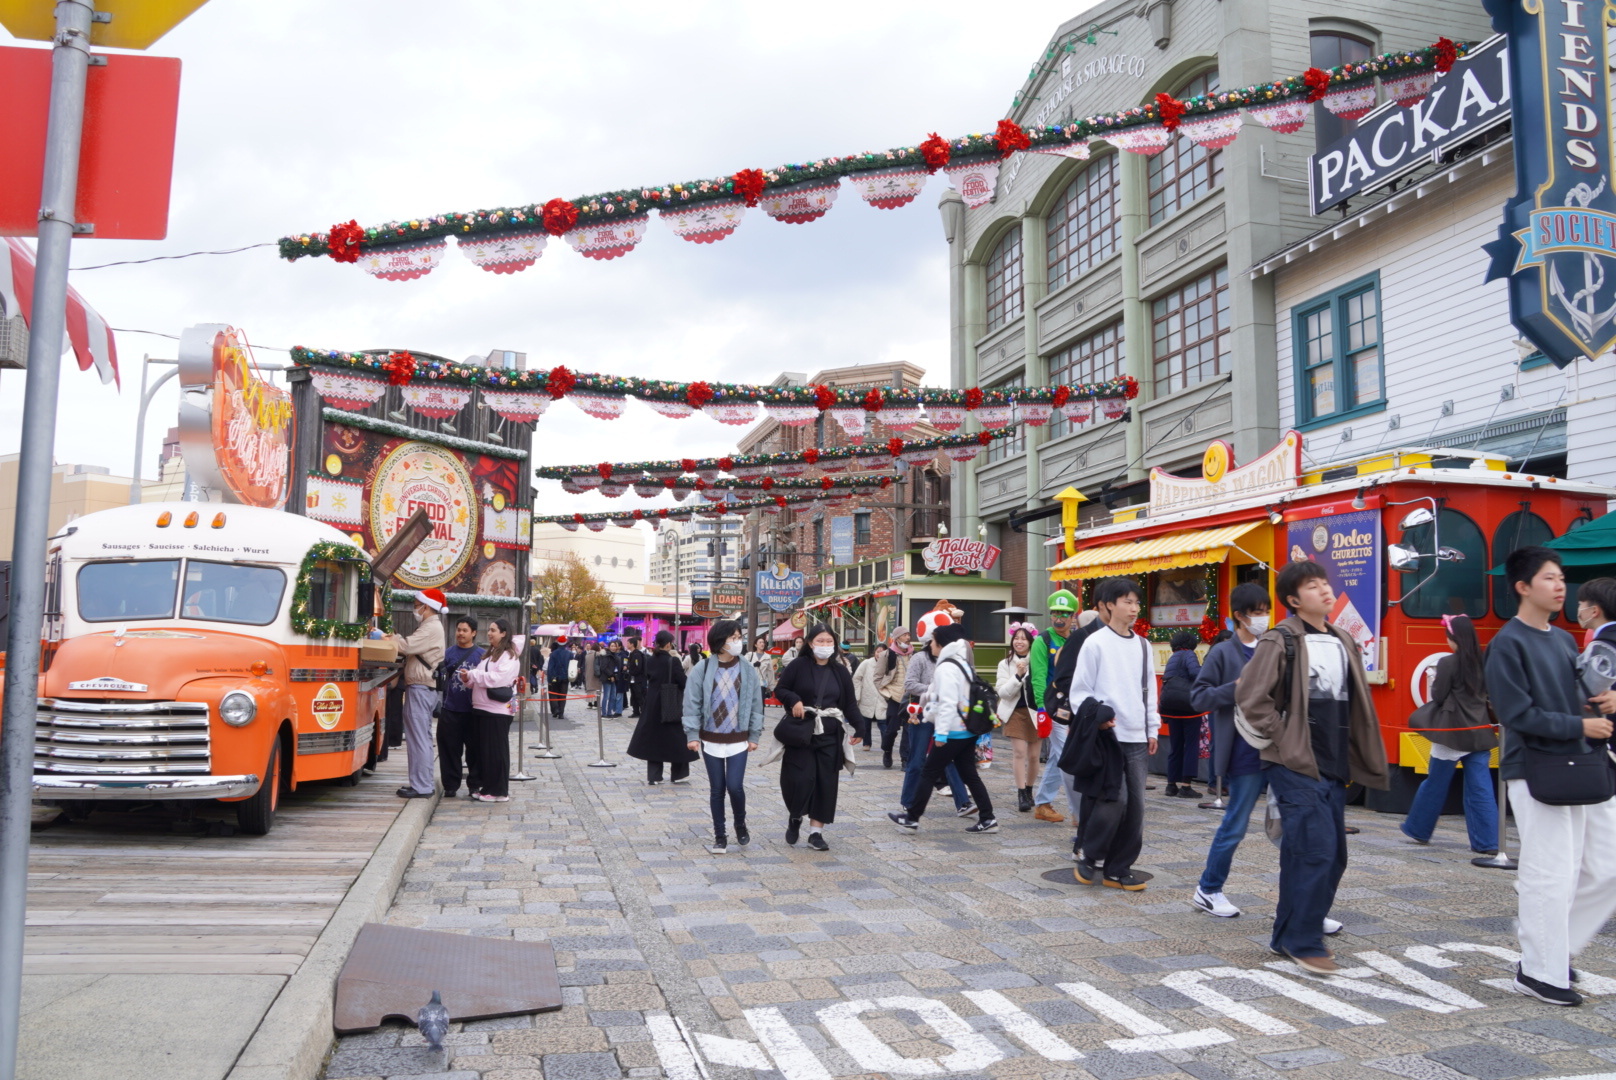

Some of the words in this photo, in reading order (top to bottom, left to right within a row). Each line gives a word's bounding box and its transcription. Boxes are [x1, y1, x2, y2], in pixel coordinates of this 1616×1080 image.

[1084, 54, 1127, 82] STORAGE
[966, 180, 984, 189] FOOD
[962, 186, 991, 196] FESTIVAL
[789, 202, 812, 210] FESTIVAL
[793, 197, 807, 205] FOOD
[594, 235, 619, 244] FESTIVAL
[598, 230, 613, 238] FOOD
[1155, 481, 1228, 510] HAPPINESS
[1232, 449, 1289, 495] WAGON
[399, 484, 427, 504] UNIVERSAL
[427, 484, 454, 511] CHRISTMAS
[1332, 528, 1372, 548] Dolce
[193, 544, 235, 553] Salchicha
[243, 547, 270, 555] Wurst
[936, 538, 985, 560] Trolley
[1331, 546, 1373, 560] CHURRITOS
[937, 552, 981, 571] Treats
[713, 594, 744, 605] LOANS
[768, 595, 792, 603] DRUGS
[316, 701, 328, 710] Hot
[328, 701, 341, 712] Dogs
